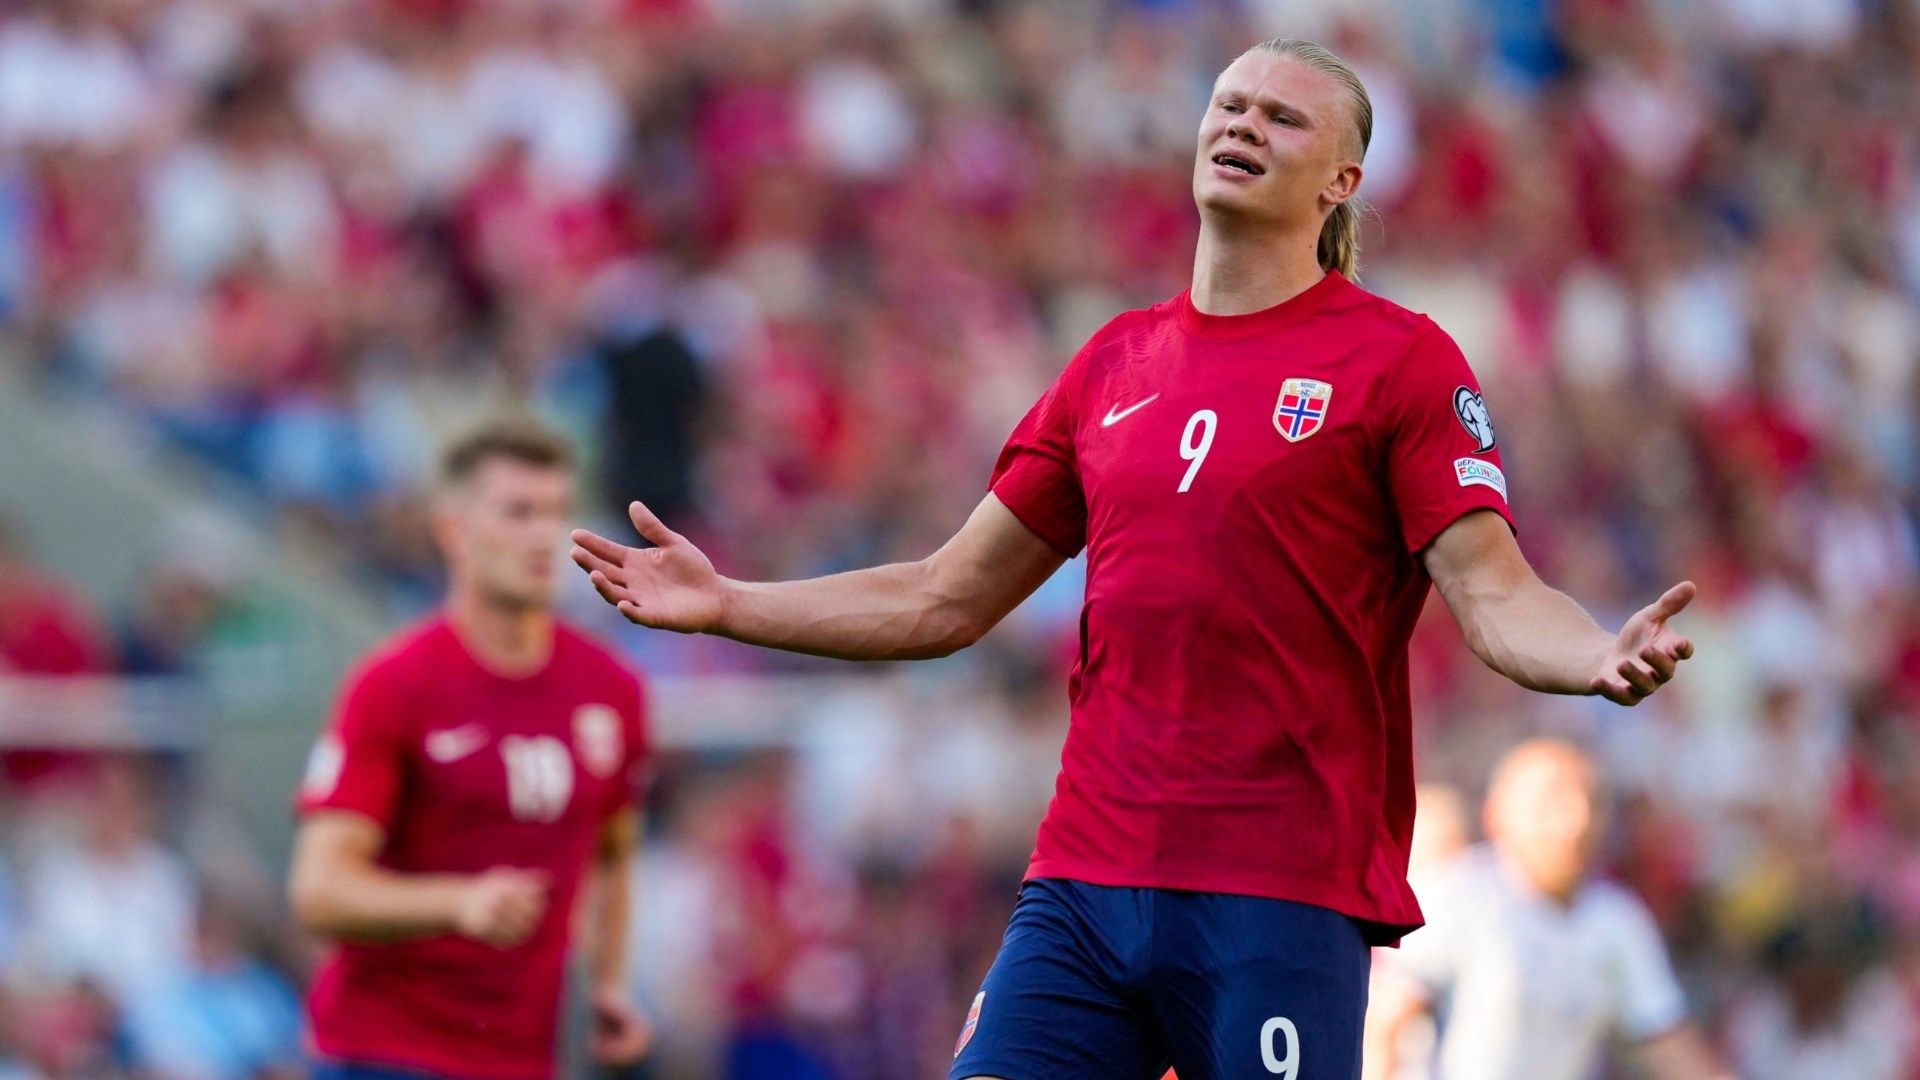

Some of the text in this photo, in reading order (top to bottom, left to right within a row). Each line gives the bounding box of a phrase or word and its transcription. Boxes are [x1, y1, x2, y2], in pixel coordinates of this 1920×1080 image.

[1177, 409, 1217, 493] 9
[1457, 459, 1476, 467] UEFA
[1260, 1016, 1300, 1080] 9
